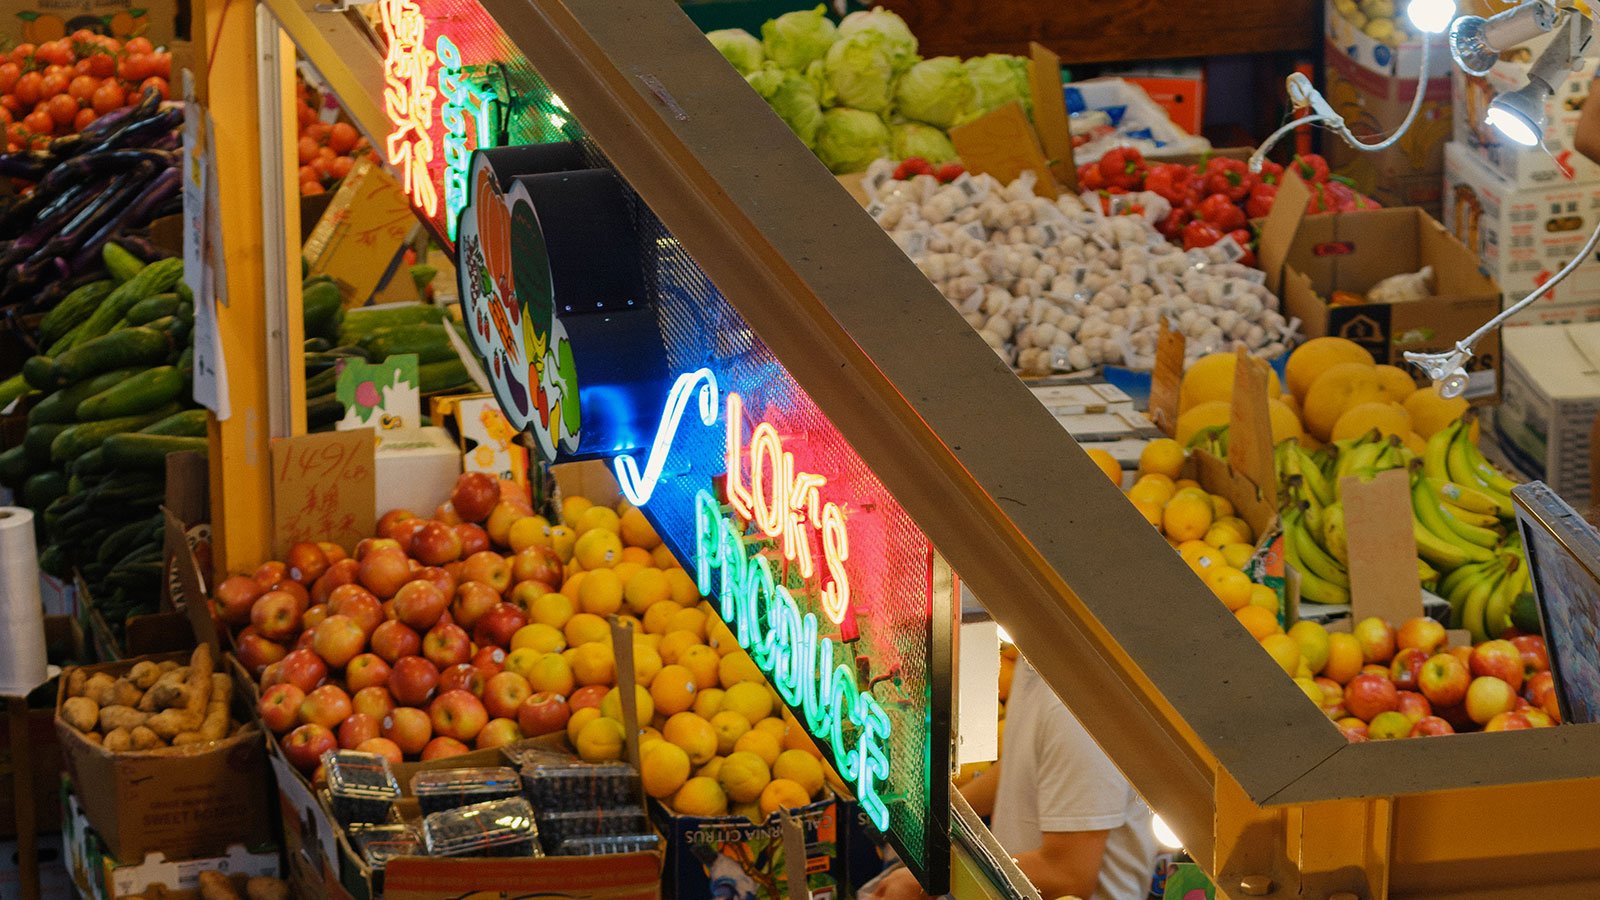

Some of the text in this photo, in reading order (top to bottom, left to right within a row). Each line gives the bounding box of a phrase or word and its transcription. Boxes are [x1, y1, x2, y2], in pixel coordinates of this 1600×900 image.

[725, 392, 851, 625] LOK'S
[694, 488, 890, 832] PRODUCE
[684, 816, 833, 844] CALRNIA CITRUS
